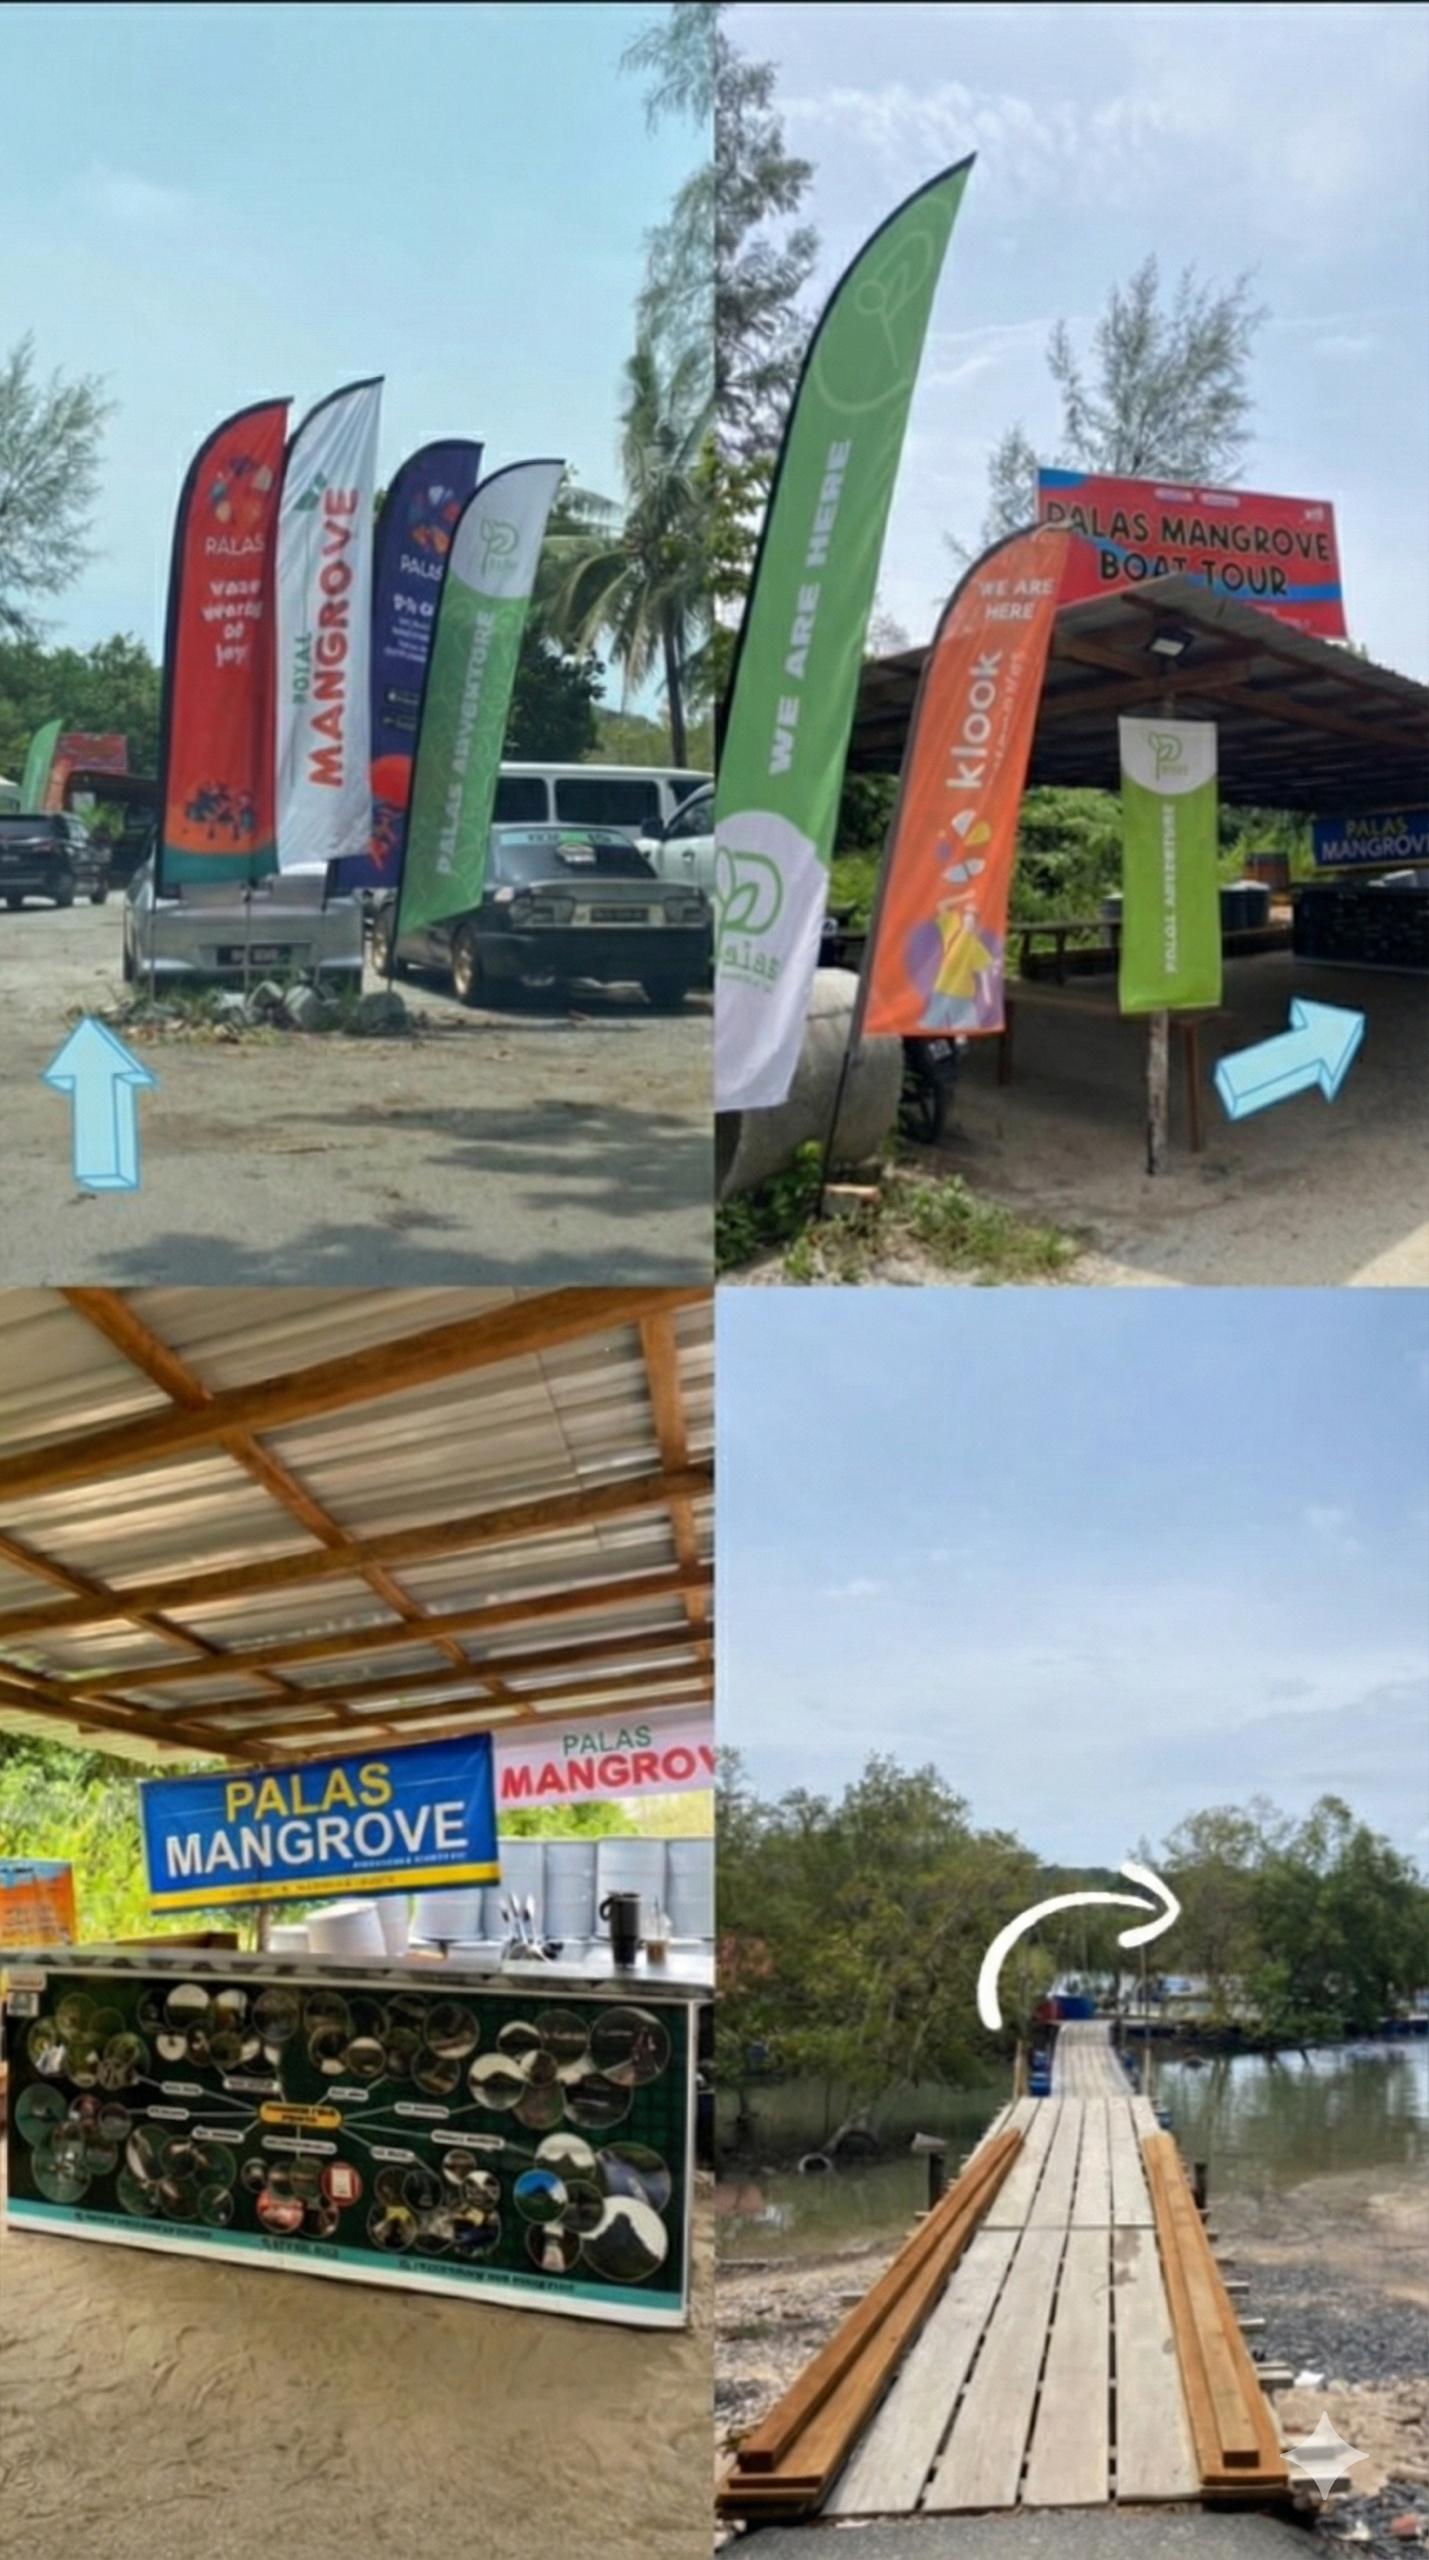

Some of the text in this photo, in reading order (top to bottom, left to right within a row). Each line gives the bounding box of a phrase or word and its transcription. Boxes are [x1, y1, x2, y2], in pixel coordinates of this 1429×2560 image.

[1161, 515, 1331, 562] MANGROVE
[978, 577, 1056, 597] WE ARE
[1202, 559, 1288, 596] TOUR
[769, 436, 852, 776] WE ARE HERE
[985, 601, 1036, 620] HERE
[308, 487, 359, 788] MANGROVE
[945, 649, 1003, 789] klook
[1321, 833, 1429, 862] MANGROV
[562, 1725, 652, 1757] PALAS
[225, 1762, 394, 1824] PALAS
[166, 1801, 470, 1879] MANGROVE
